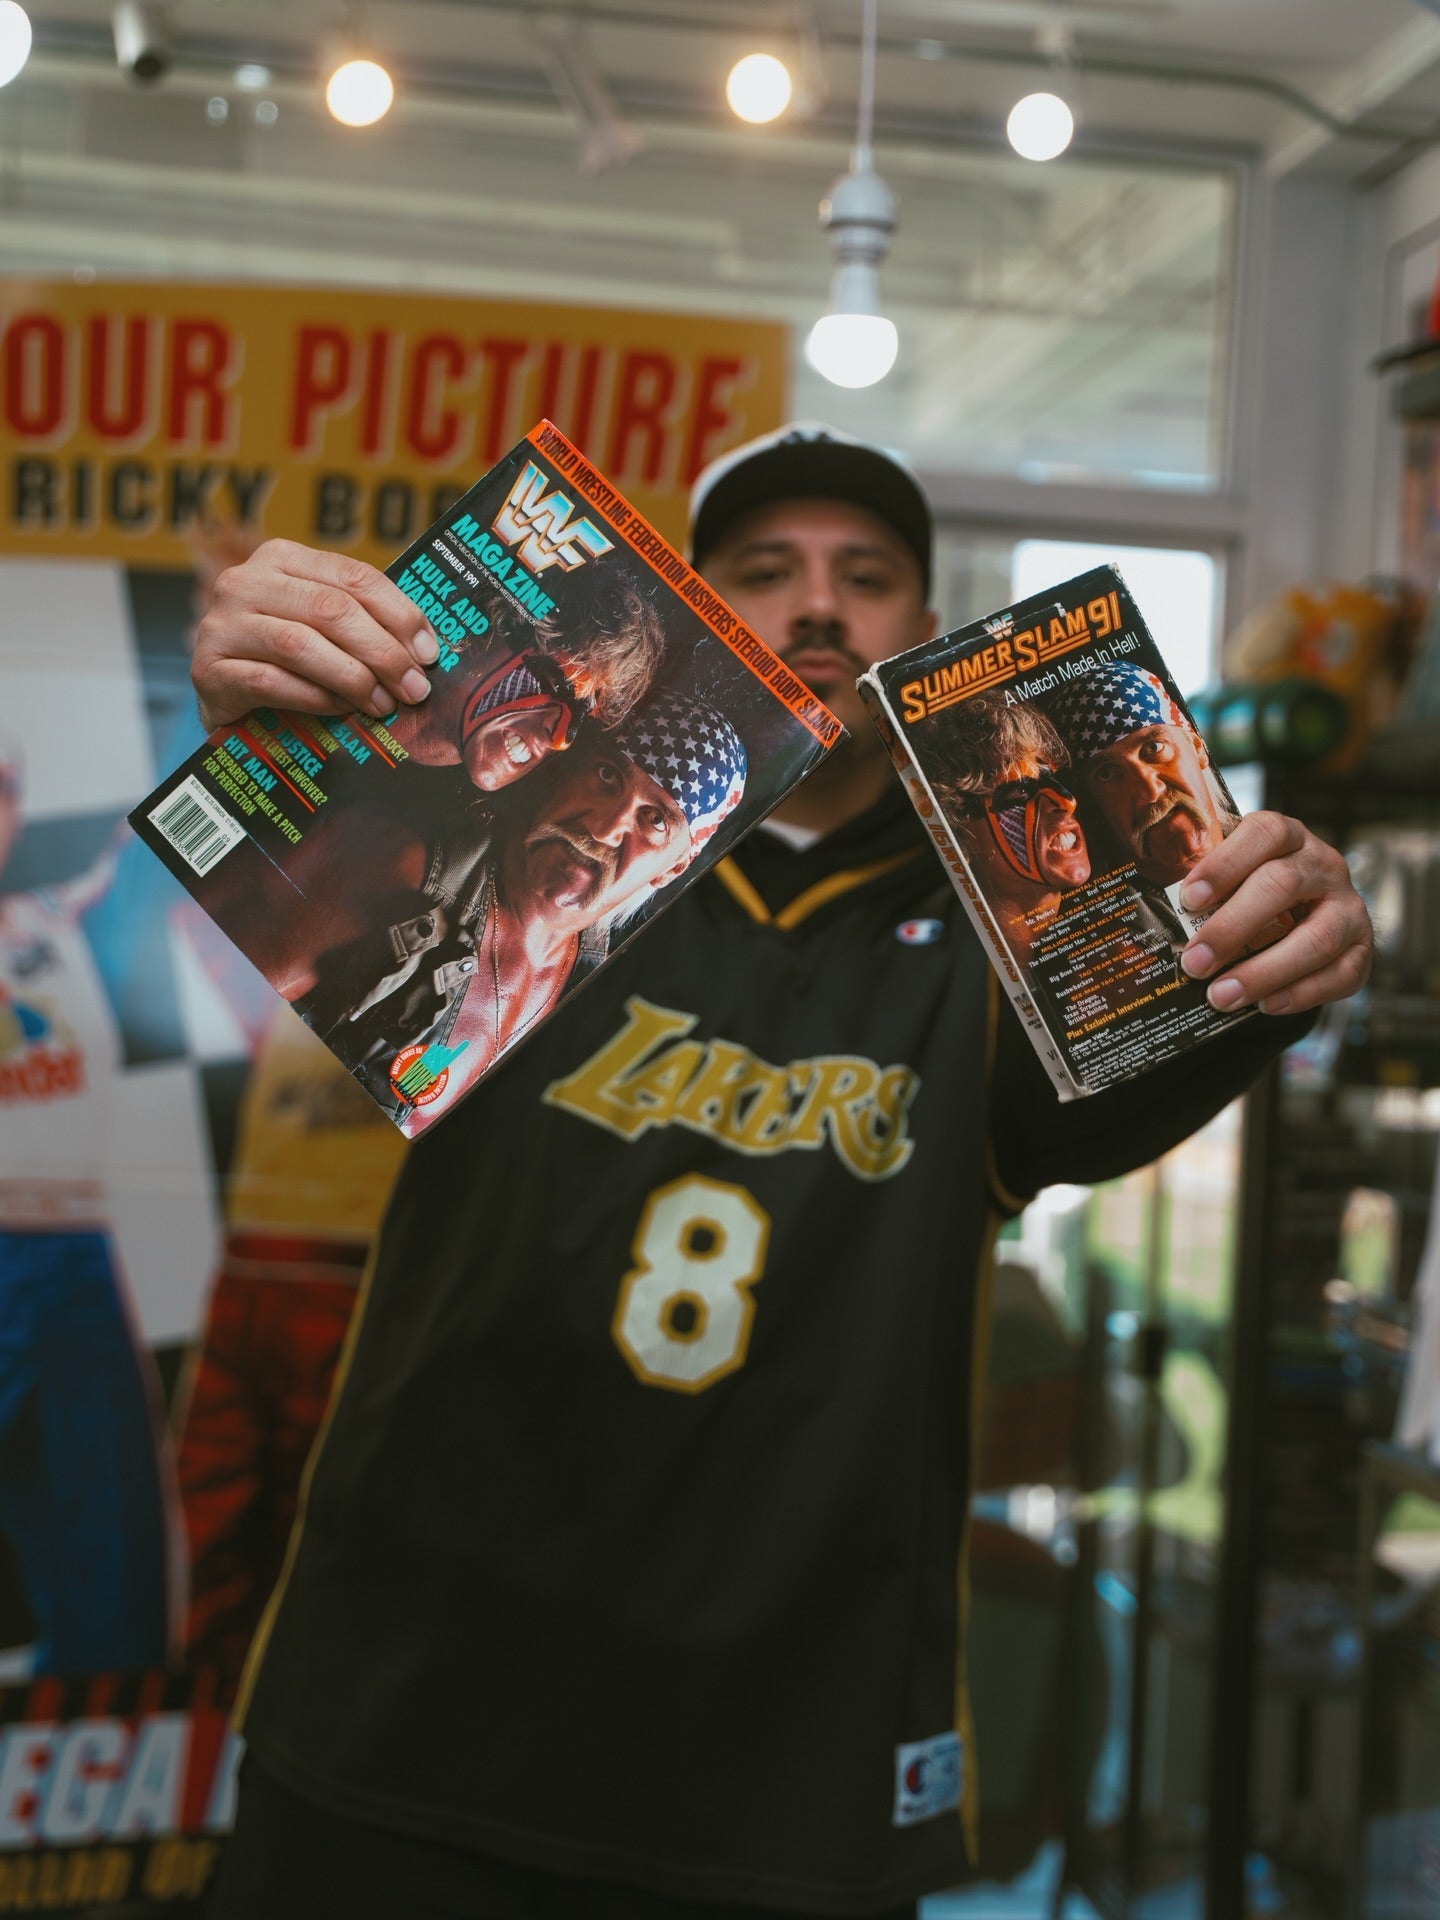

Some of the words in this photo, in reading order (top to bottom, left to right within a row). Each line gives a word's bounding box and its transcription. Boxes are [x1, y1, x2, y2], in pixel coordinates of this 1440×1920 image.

[12, 457, 272, 532] RICKY
[430, 537, 466, 574] SEPTEMBER
[461, 570, 480, 588] 1991
[449, 510, 556, 622] MAGAZINE
[486, 573, 502, 590] WORLD
[409, 552, 457, 602] HULK
[449, 594, 492, 638] AND
[534, 426, 580, 473] WORLD
[567, 460, 633, 528] WRESTLING
[621, 516, 690, 587] FEDERATION
[678, 575, 739, 637] ANSWERS
[726, 624, 778, 678] STEROID
[767, 668, 807, 708] BODY
[794, 695, 842, 744] SLAMS
[393, 567, 468, 647] WARRIOR
[1000, 689, 1017, 707] A
[1014, 669, 1060, 701] Match
[1056, 652, 1097, 681] Made
[1094, 645, 1111, 664] In
[1107, 631, 1141, 657] Hell!
[222, 733, 249, 762] HIT
[242, 754, 278, 793] MAN
[274, 724, 324, 779] JUSTICE
[370, 721, 410, 764] WEDLOCK?
[201, 755, 221, 776] FOR
[214, 769, 258, 817] PERFECTION
[211, 745, 250, 787] PREPARED
[265, 739, 293, 769] LATEST
[286, 762, 328, 808] LAWGIVER?
[243, 780, 259, 797] TO
[252, 790, 278, 817] MAKE
[271, 811, 284, 824] A
[277, 817, 303, 845] PITCH
[1110, 860, 1136, 876] MATCH
[1034, 907, 1056, 921] Perfect
[1064, 904, 1084, 916] TEAM
[1102, 883, 1128, 898] MATCH
[1028, 939, 1041, 949] The
[1040, 931, 1057, 944] Nasty
[1056, 924, 1071, 936] Boys
[1100, 901, 1121, 915] Legion
[1039, 935, 1069, 953] MILLION
[1068, 922, 1097, 939] DOLLAR
[1113, 902, 1138, 918] MATCH
[1103, 925, 1129, 941] MATCH
[1028, 958, 1040, 968] The
[1038, 949, 1059, 963] Million
[1057, 941, 1075, 954] Dollar
[1073, 935, 1087, 946] Man
[1048, 973, 1061, 984] Big
[1058, 967, 1073, 978] Boss
[1071, 960, 1086, 972] Man
[1120, 937, 1134, 947] The
[1092, 959, 1112, 972] TEAM
[1111, 946, 1137, 962] MATCH
[1133, 955, 1158, 970] MATCH
[1054, 975, 1095, 999] Bushwhackers
[1064, 1002, 1077, 1012] The
[1062, 1008, 1080, 1021] Texas
[1078, 997, 1102, 1013] Tornado
[1065, 1026, 1084, 1040] Plus
[1082, 1010, 1117, 1032] Exclusive
[1115, 991, 1155, 1015] Interviews,
[1153, 978, 1181, 997] Behind
[1066, 1012, 1088, 1026] British
[1086, 1002, 1109, 1017] Bulldog
[1067, 1037, 1093, 1054] Coliseum
[541, 994, 922, 1183] LAKERS
[611, 1171, 772, 1396] 8
